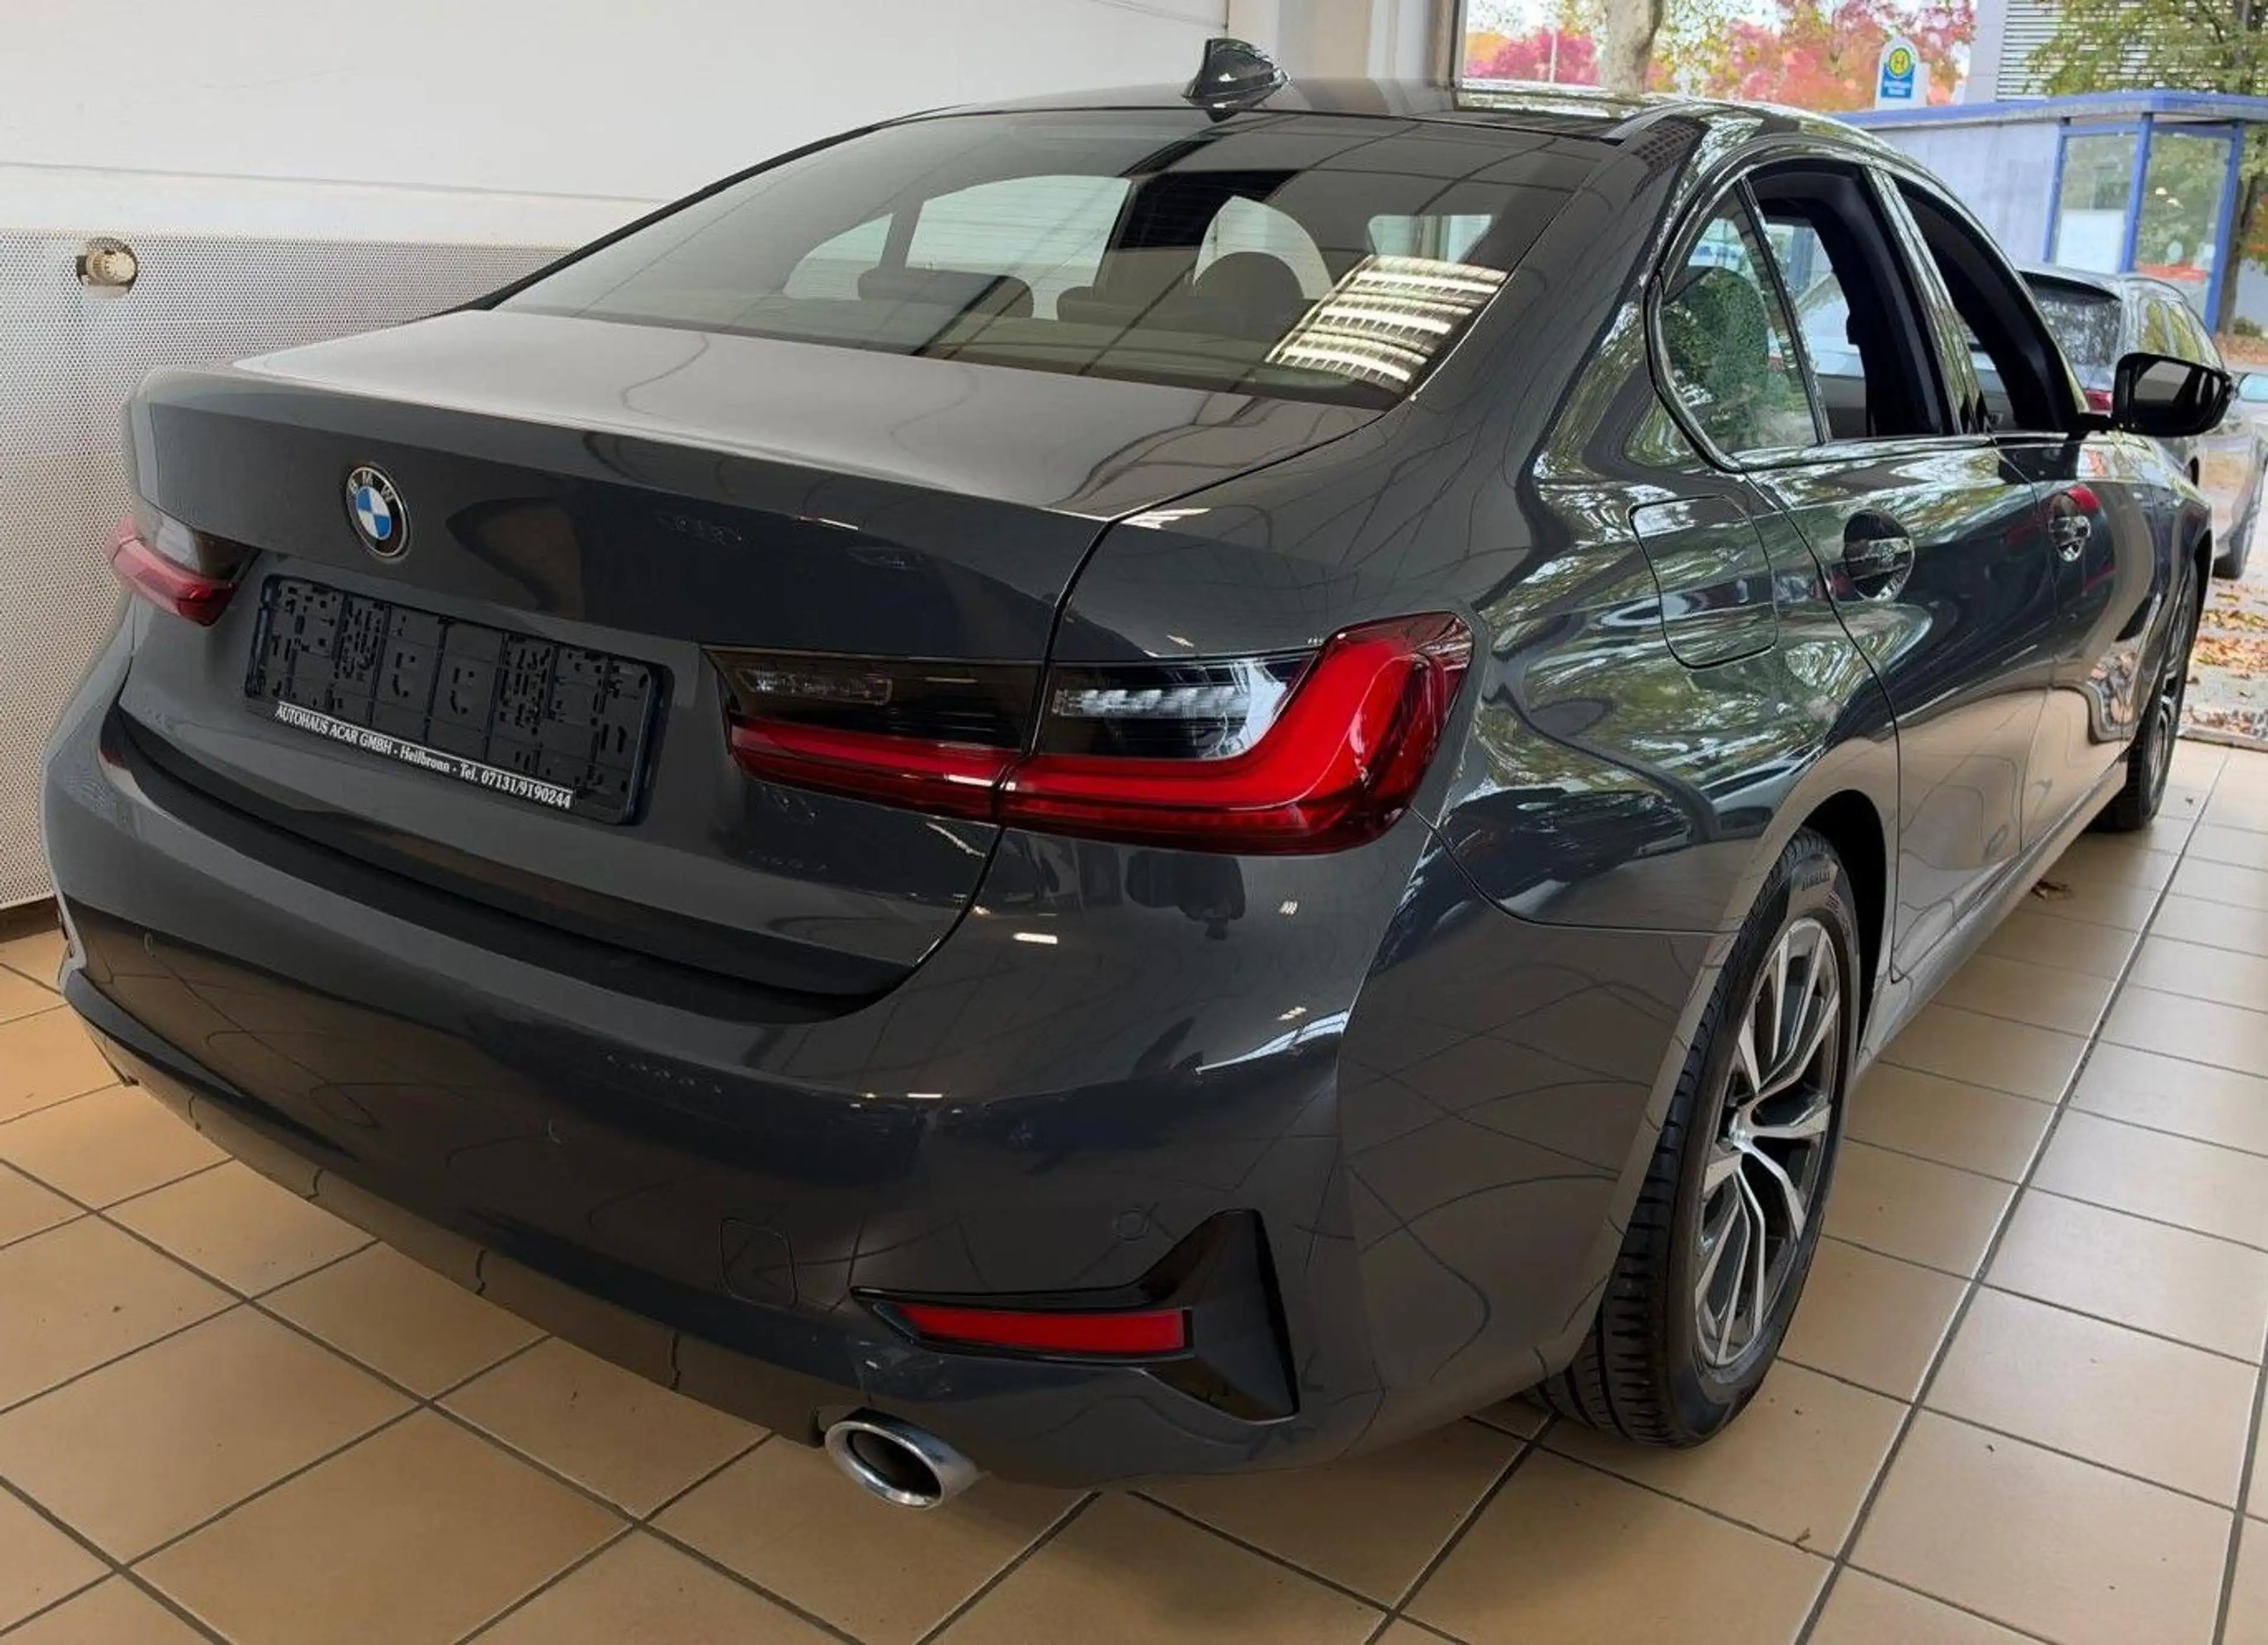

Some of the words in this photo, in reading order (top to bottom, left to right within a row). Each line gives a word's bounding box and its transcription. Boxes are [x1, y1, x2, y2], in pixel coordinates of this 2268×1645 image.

[348, 471, 395, 503] BMW
[275, 704, 328, 735] AUTOHAUS
[330, 724, 359, 744] ACAR
[359, 733, 393, 755] GMBH
[399, 745, 450, 773] Heilbronn
[460, 762, 478, 782] Tel.
[481, 770, 572, 810] 07131/9190244
